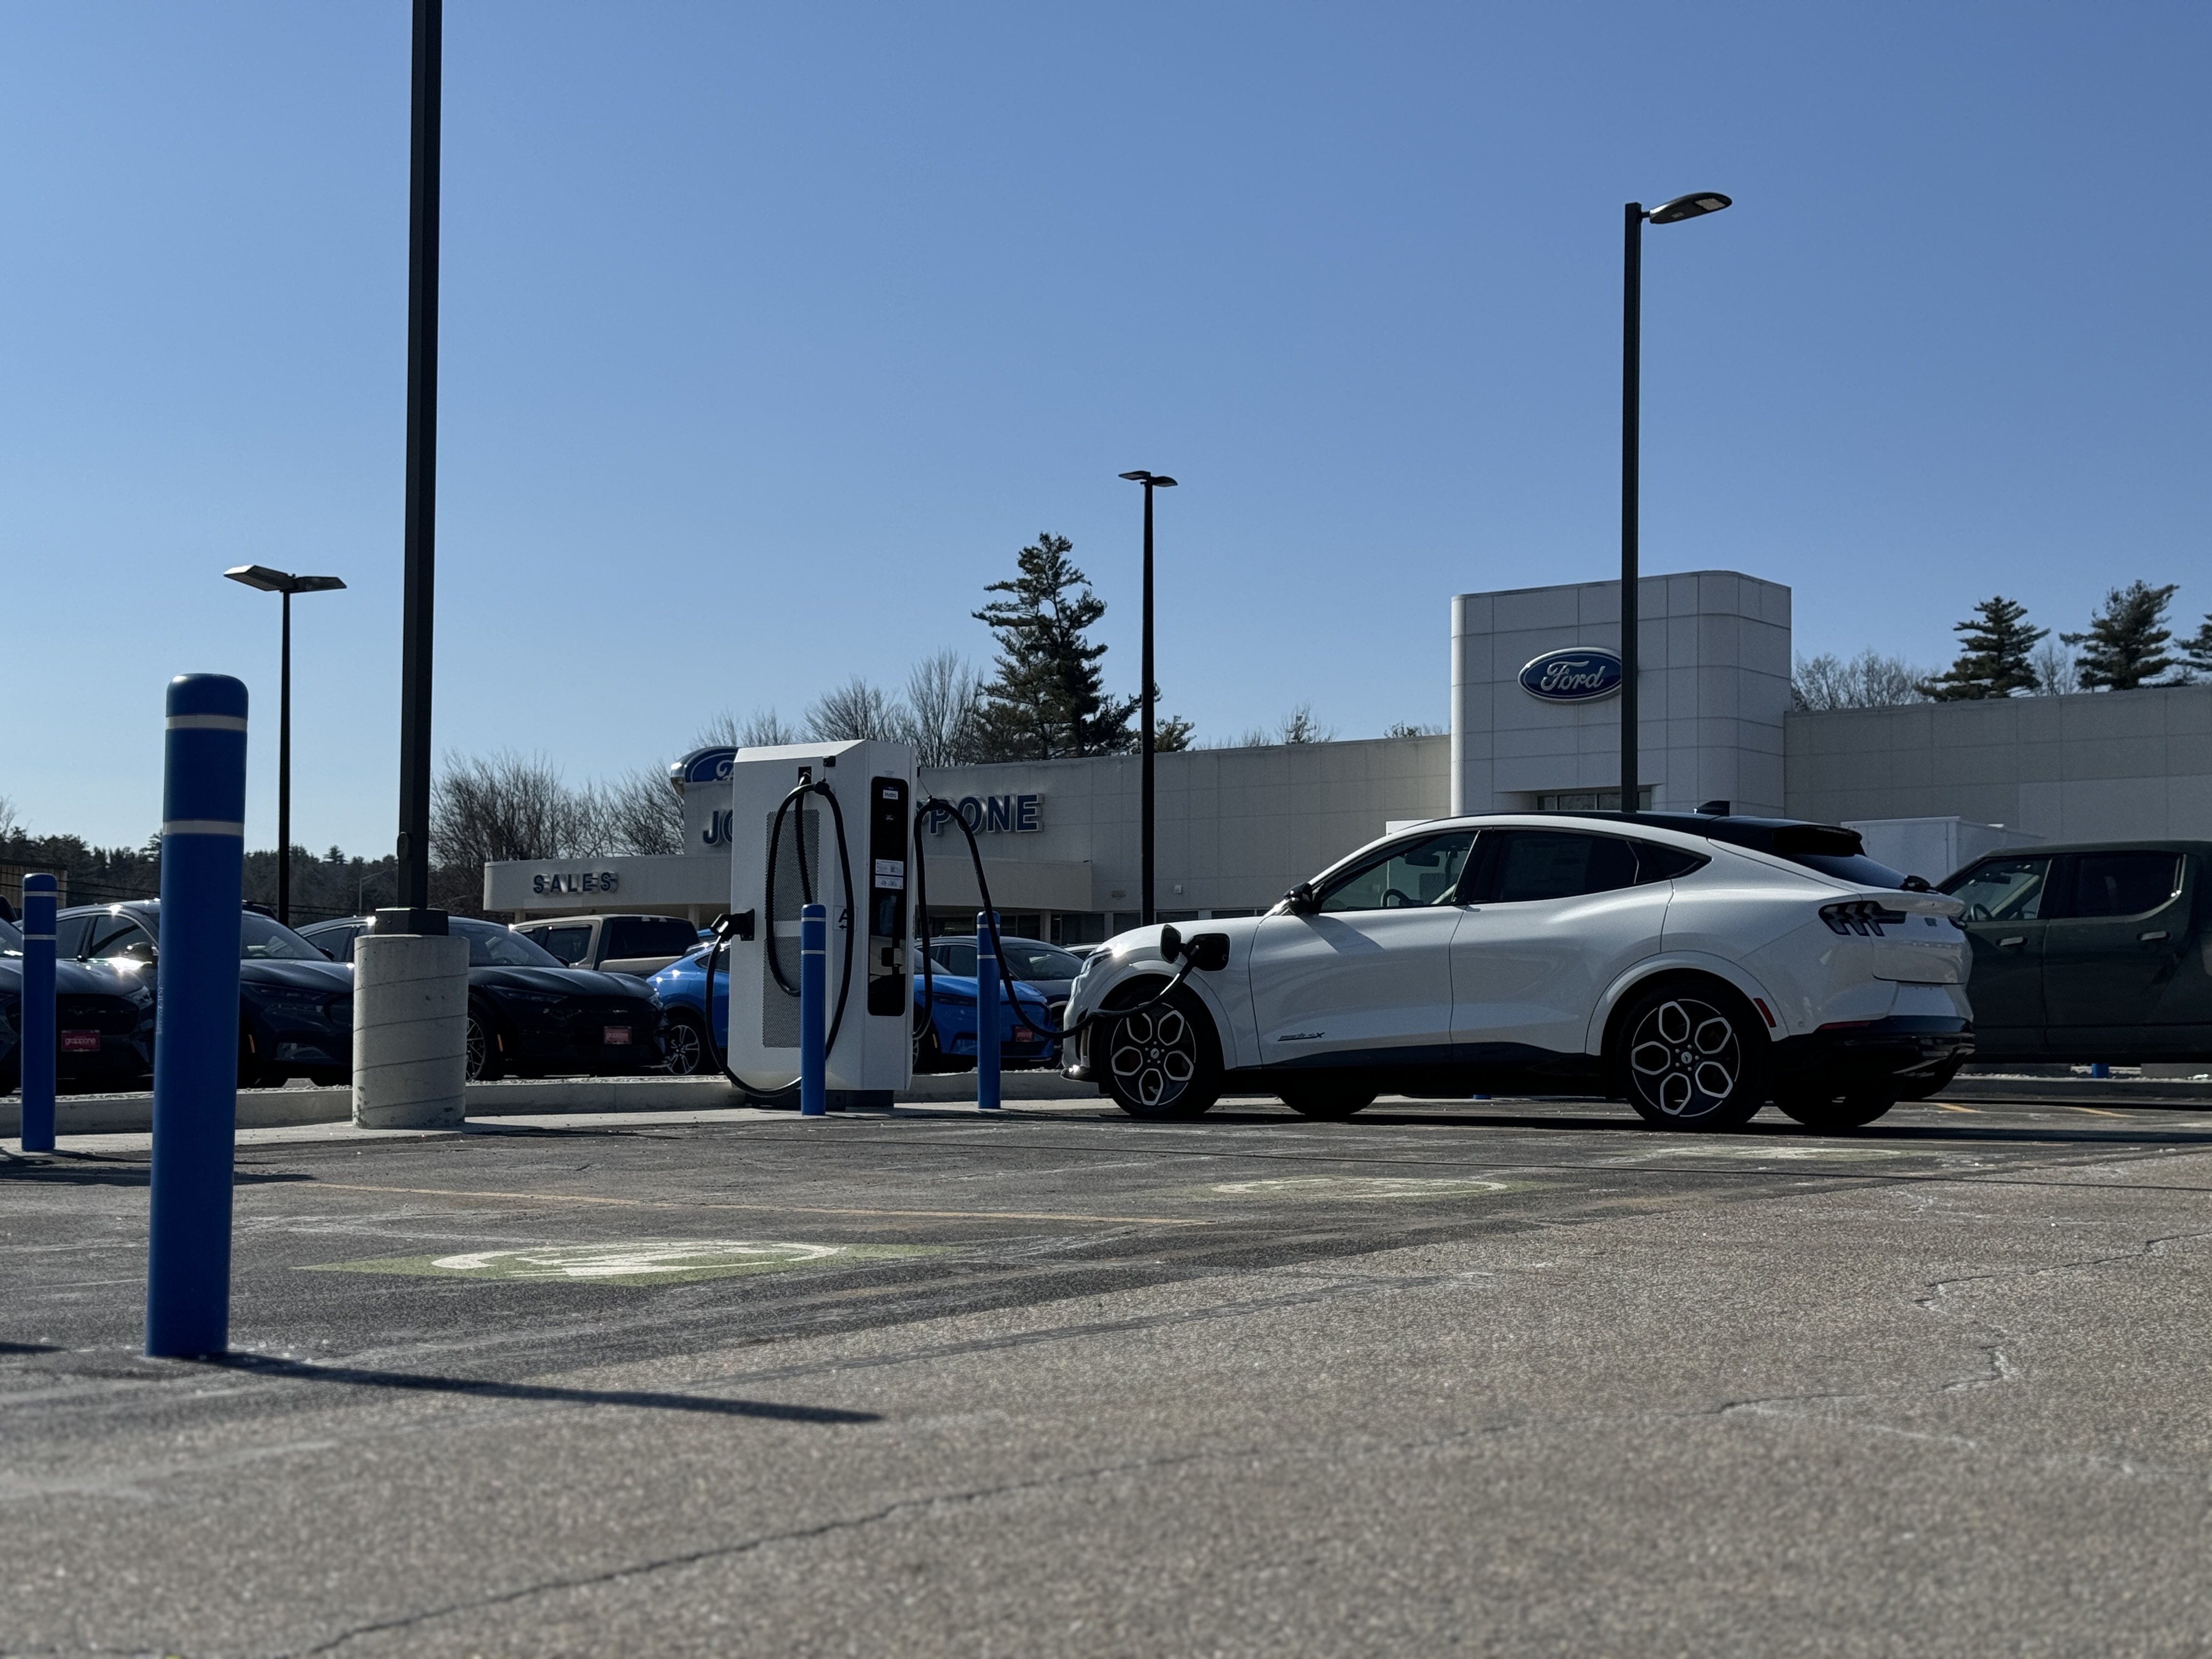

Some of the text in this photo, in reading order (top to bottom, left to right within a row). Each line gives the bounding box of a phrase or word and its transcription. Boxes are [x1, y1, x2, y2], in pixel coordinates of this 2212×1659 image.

[1541, 660, 1606, 691] Ford
[917, 795, 1039, 834] PONE
[533, 871, 618, 894] SALES
